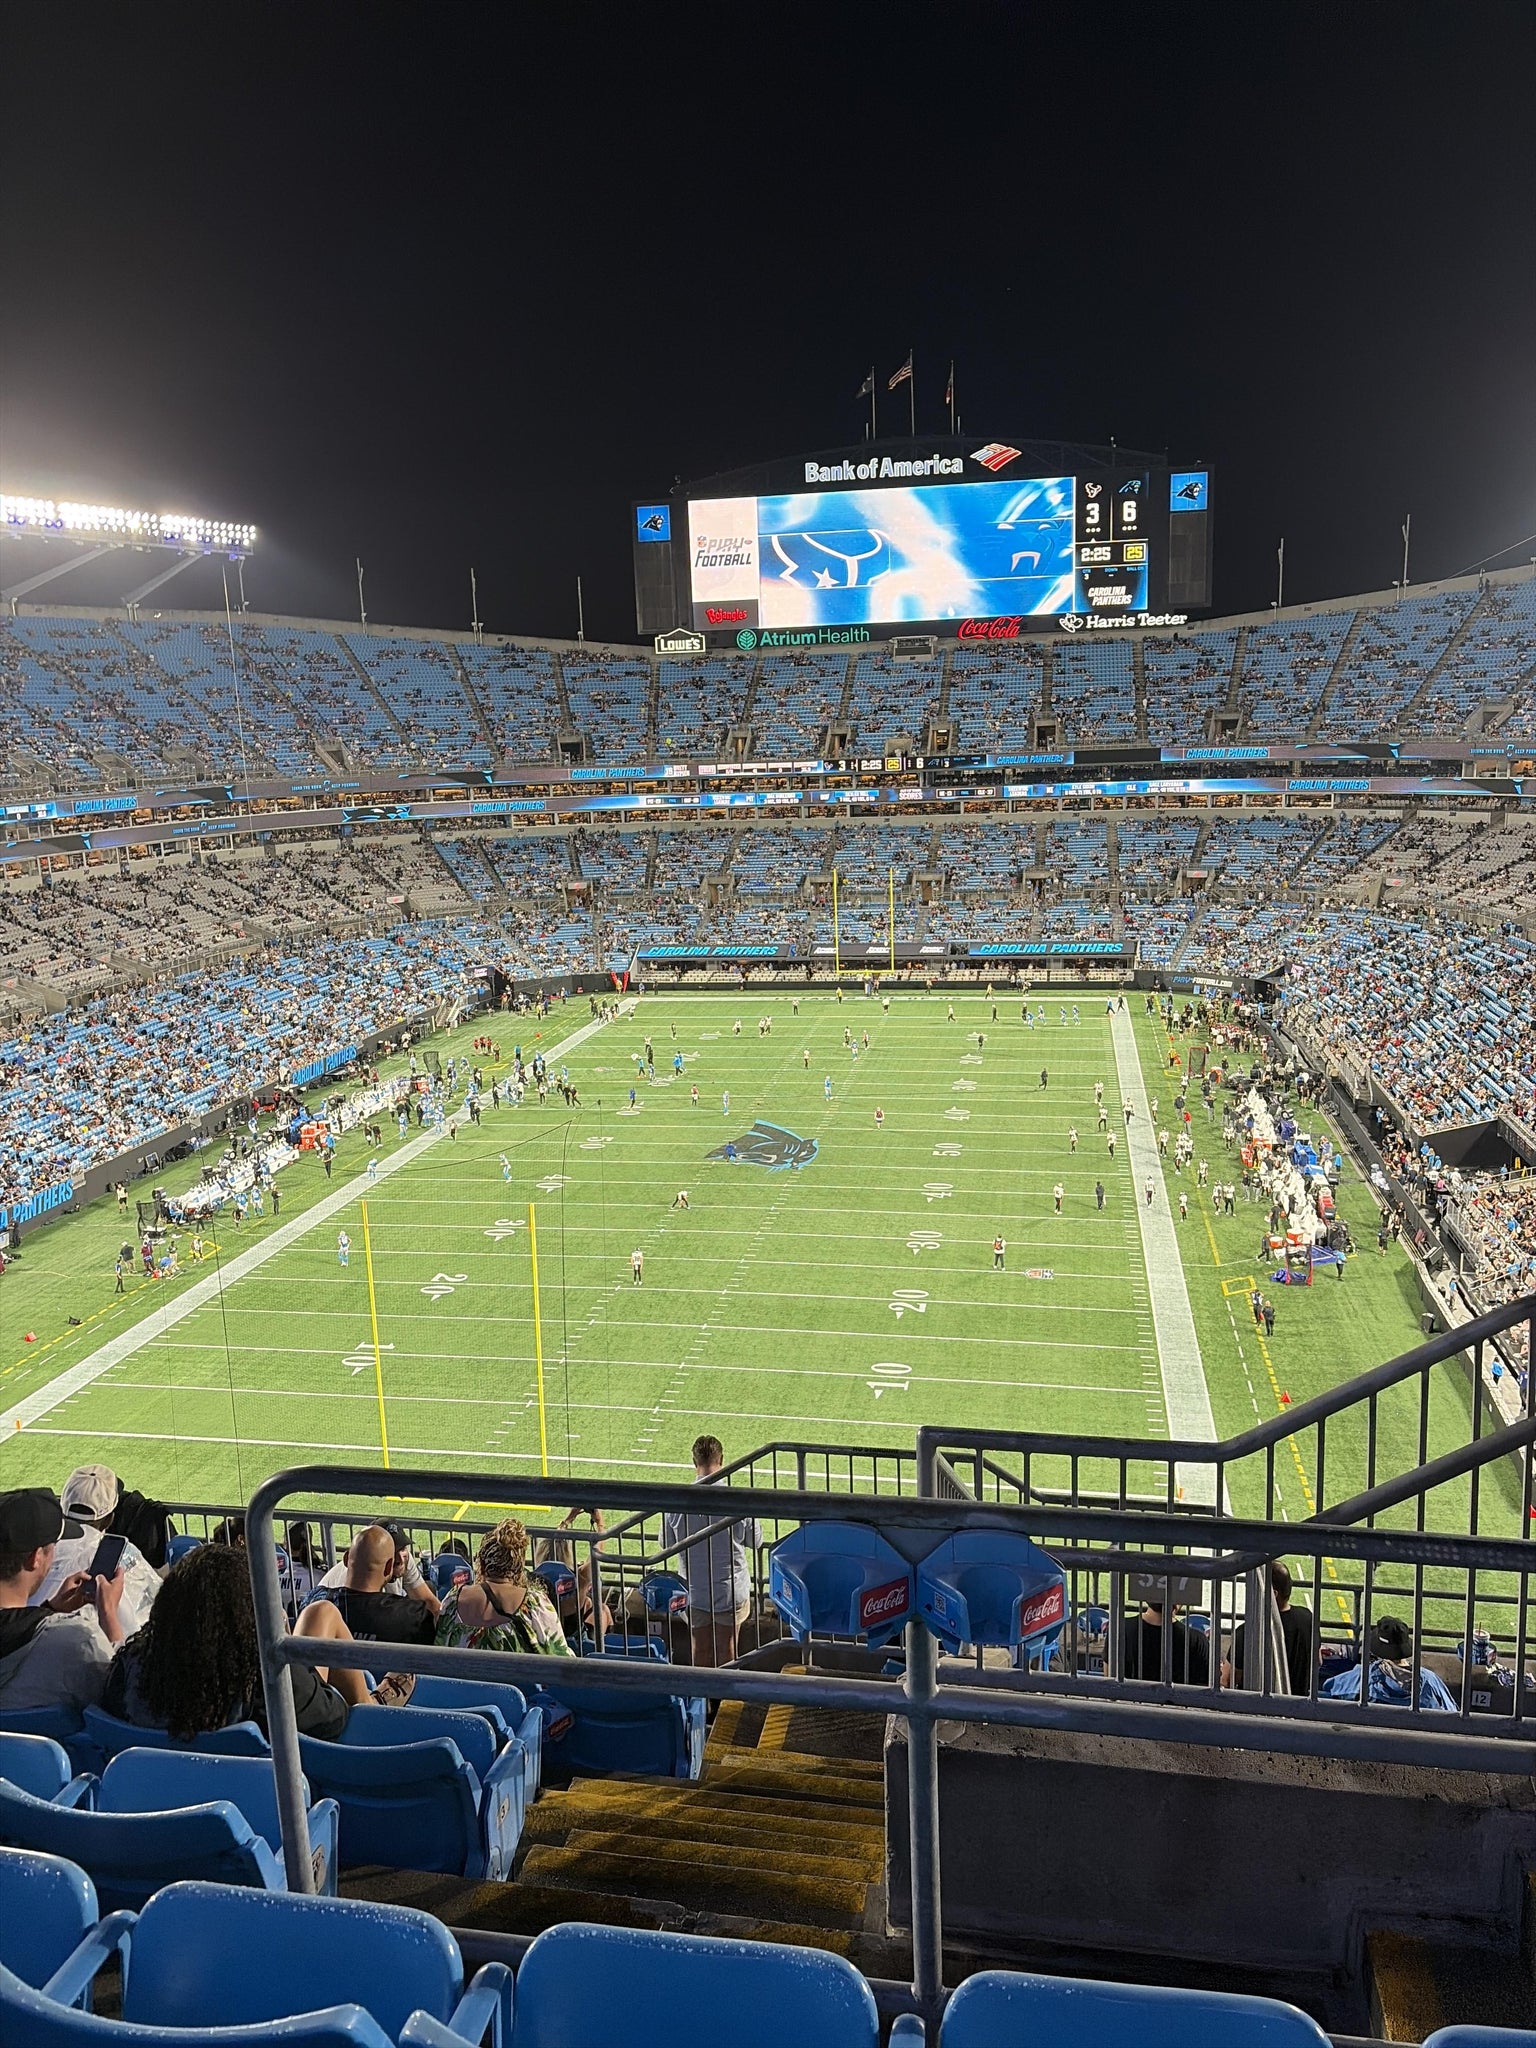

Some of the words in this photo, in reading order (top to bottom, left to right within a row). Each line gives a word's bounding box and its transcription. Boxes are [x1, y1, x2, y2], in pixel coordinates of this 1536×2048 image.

[805, 460, 856, 483] Bank
[857, 457, 878, 479] of
[880, 454, 963, 478] America
[1086, 503, 1099, 524] 3
[1123, 501, 1136, 521] 6
[695, 550, 752, 568] FOOTBALL
[1081, 547, 1111, 562] 2:25
[1127, 546, 1143, 560] 25
[1088, 586, 1126, 597] CAROLINA
[1092, 594, 1132, 606] PANTHERS
[705, 608, 748, 624] Bojangles
[1086, 615, 1135, 629] Harris
[1137, 613, 1188, 627] Teeter
[957, 616, 1023, 641] Coca-Cola
[760, 627, 816, 646] Atrium
[818, 627, 870, 643] Health
[997, 756, 1028, 765] CAROLINA
[1030, 755, 1063, 764] PANTHERS
[1186, 748, 1225, 758] CAROLINA
[1227, 747, 1268, 757] PANTHERS
[839, 761, 846, 771] 3
[861, 760, 882, 770] 2:25
[887, 759, 899, 769] 25
[916, 758, 924, 768] 6
[572, 769, 606, 779] CAROLINA
[609, 767, 645, 778] PANTHERS
[1289, 780, 1328, 790] CAROLINA
[1329, 779, 1370, 790] PANTHERS
[75, 799, 103, 813] CAROLINA
[105, 796, 137, 810] PANTHERS
[473, 803, 506, 812] CAROLINA
[509, 801, 545, 811] PANTHERS
[650, 946, 710, 957] CAROLINA
[712, 946, 779, 956] PANTHERS
[980, 944, 1047, 954] CAROLINA
[1051, 943, 1124, 953] PANTHERS
[326, 1043, 357, 1072] PANTHERS
[579, 1136, 614, 1149] 50
[932, 1143, 962, 1157] 50
[536, 1174, 571, 1188] 40
[921, 1183, 953, 1199] 40
[13, 1179, 73, 1223] PANTHERS
[484, 1219, 526, 1236] 30
[906, 1231, 942, 1250] 30
[420, 1273, 468, 1294] 20
[888, 1289, 929, 1313] 20
[341, 1342, 395, 1366] 10
[866, 1363, 912, 1391] 10
[279, 1577, 302, 1590] MIH
[864, 1586, 905, 1617] Coca-Cola
[1024, 1593, 1061, 1625] Coca-Cola
[1475, 1694, 1487, 1704] 12
